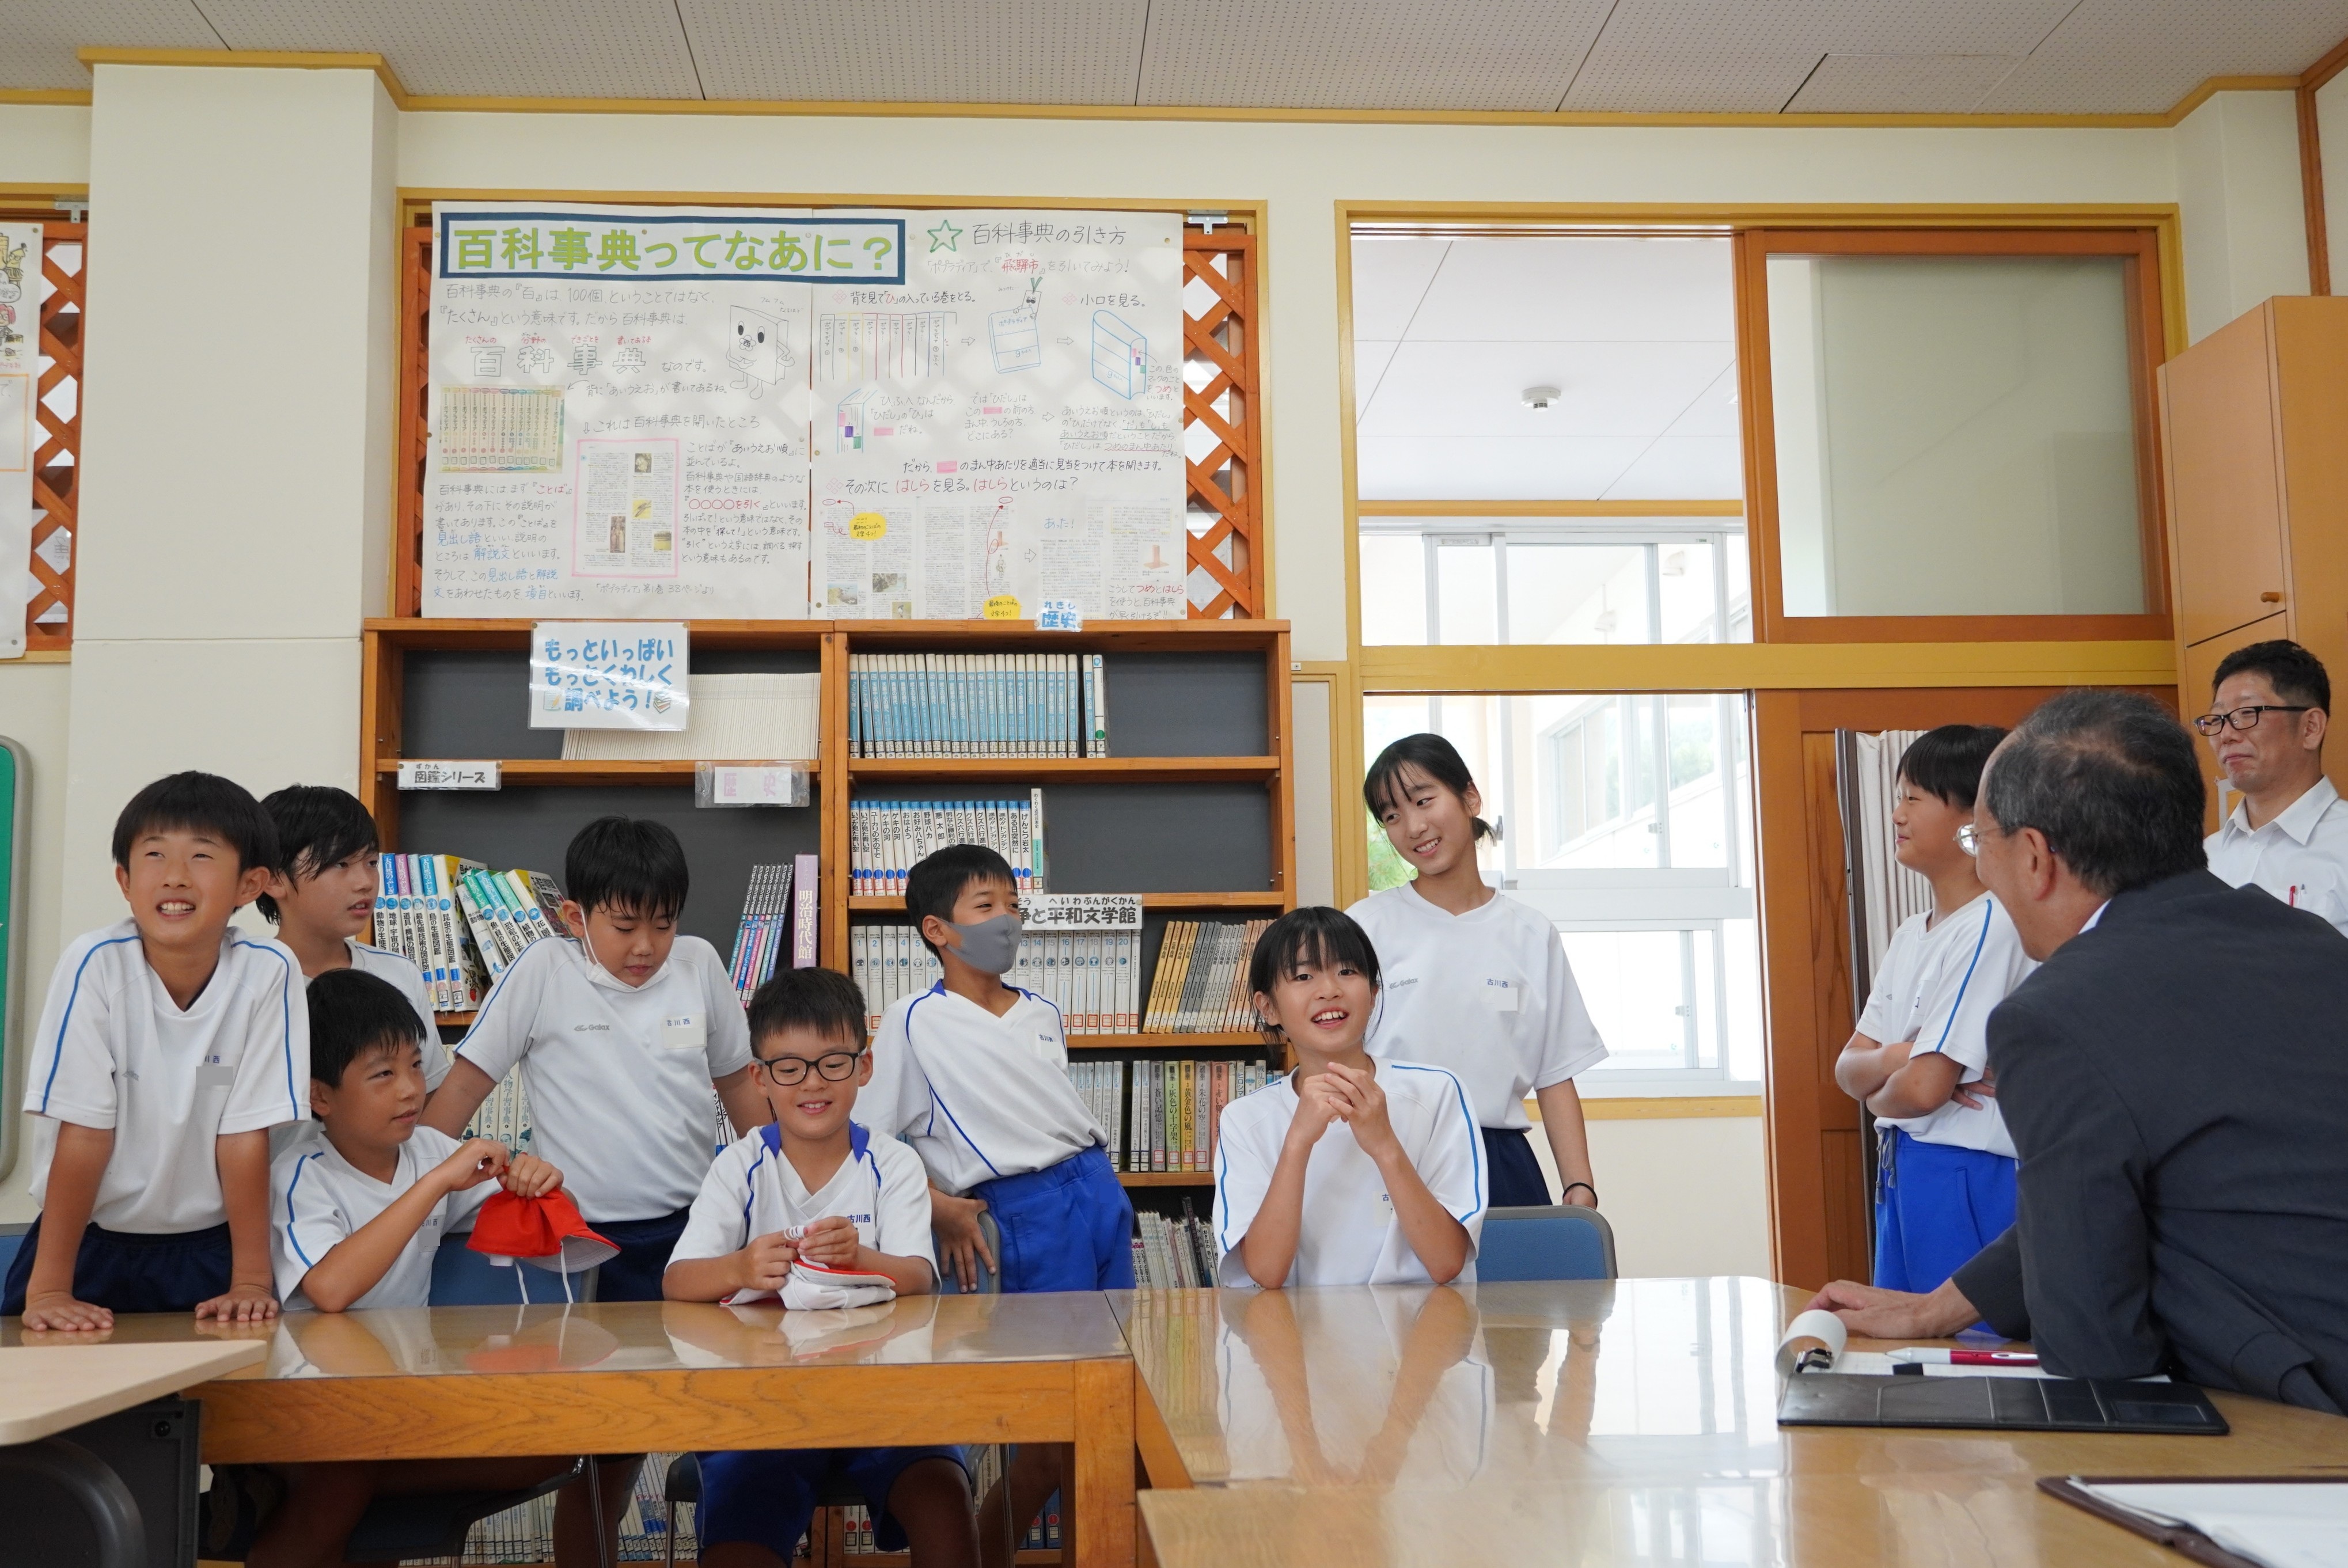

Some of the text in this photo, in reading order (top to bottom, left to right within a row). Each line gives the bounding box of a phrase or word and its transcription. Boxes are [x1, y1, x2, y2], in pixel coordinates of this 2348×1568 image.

[973, 220, 1126, 246] 百科事典の引き方
[454, 227, 892, 272] 百科事典ってなあに？
[1080, 293, 1145, 308] 小口を見る。
[661, 359, 708, 373] なのです。
[593, 414, 761, 433] これは百科事典を開いたところ
[685, 457, 741, 468] 並んでいるよ。
[686, 471, 806, 483] 百科事典や国語辞典のような
[682, 553, 771, 564] という意味もあるのです。
[1108, 584, 1184, 595] こうしてつめとはしら
[1044, 601, 1076, 609] れきし
[1042, 611, 1076, 628] 歴史
[544, 639, 674, 662] もっといっぱい
[544, 664, 674, 687] もっとくわしく
[564, 687, 652, 713] 調べよう！
[414, 770, 486, 785] 図鑑シリーズ
[870, 812, 881, 859] ユーカリの木の下で
[902, 812, 912, 840] おはよう
[923, 812, 932, 839] 野球バカ
[935, 812, 944, 840] 悪太郎
[1010, 812, 1019, 854] ある日突然に
[429, 913, 442, 955] 鳥の生態図鑑
[798, 889, 813, 960] 明治時代館
[443, 913, 456, 963] 昆虫の生態図鑑
[1118, 937, 1128, 946] 20
[1399, 978, 1419, 986] Galax
[1486, 978, 1509, 988] 古川西
[587, 1023, 610, 1032] Galax
[666, 1018, 690, 1027] 古川西
[1169, 1089, 1178, 1141] 灰色の十字架
[1184, 1088, 1192, 1131] 黄金色の風
[1198, 1089, 1206, 1123] 朱花の空
[847, 1213, 871, 1224] 古川西
